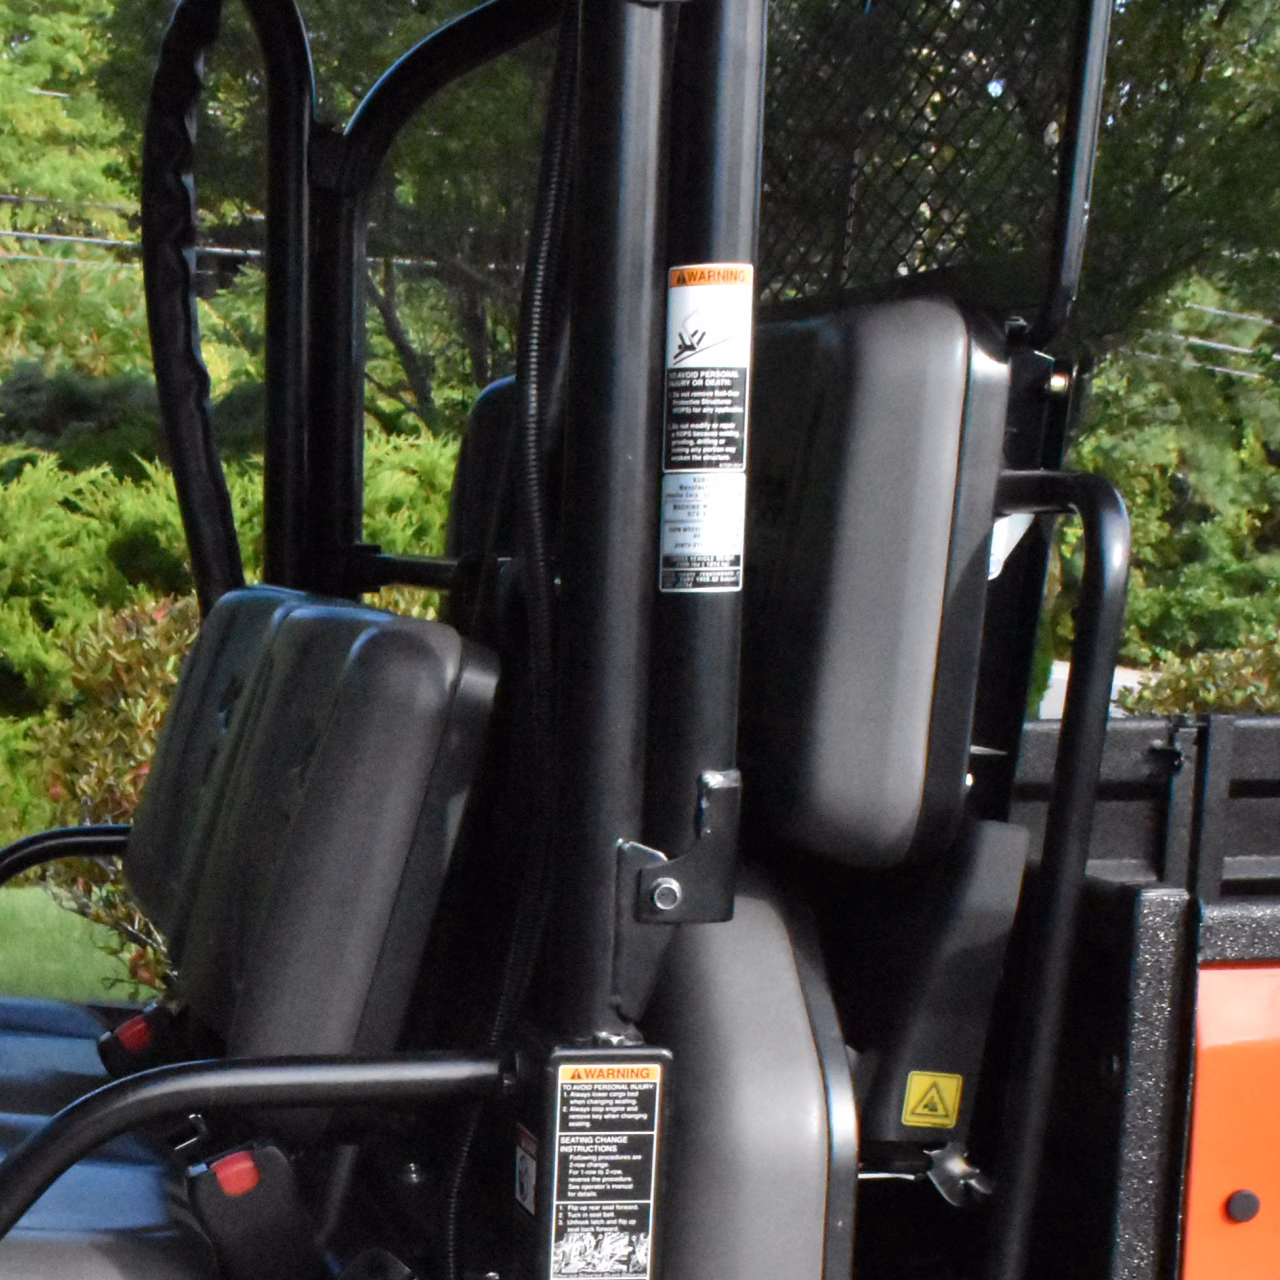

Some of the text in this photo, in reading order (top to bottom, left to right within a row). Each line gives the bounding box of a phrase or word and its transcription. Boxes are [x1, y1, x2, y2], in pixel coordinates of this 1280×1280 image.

[686, 270, 745, 282] WARNING
[700, 370, 739, 378] PERSONAL
[584, 1068, 650, 1079] WARNING
[560, 1136, 629, 1144] SEATING CHANGE
[560, 1145, 618, 1153] INSTRUCTIONS
[569, 1154, 597, 1162] Following
